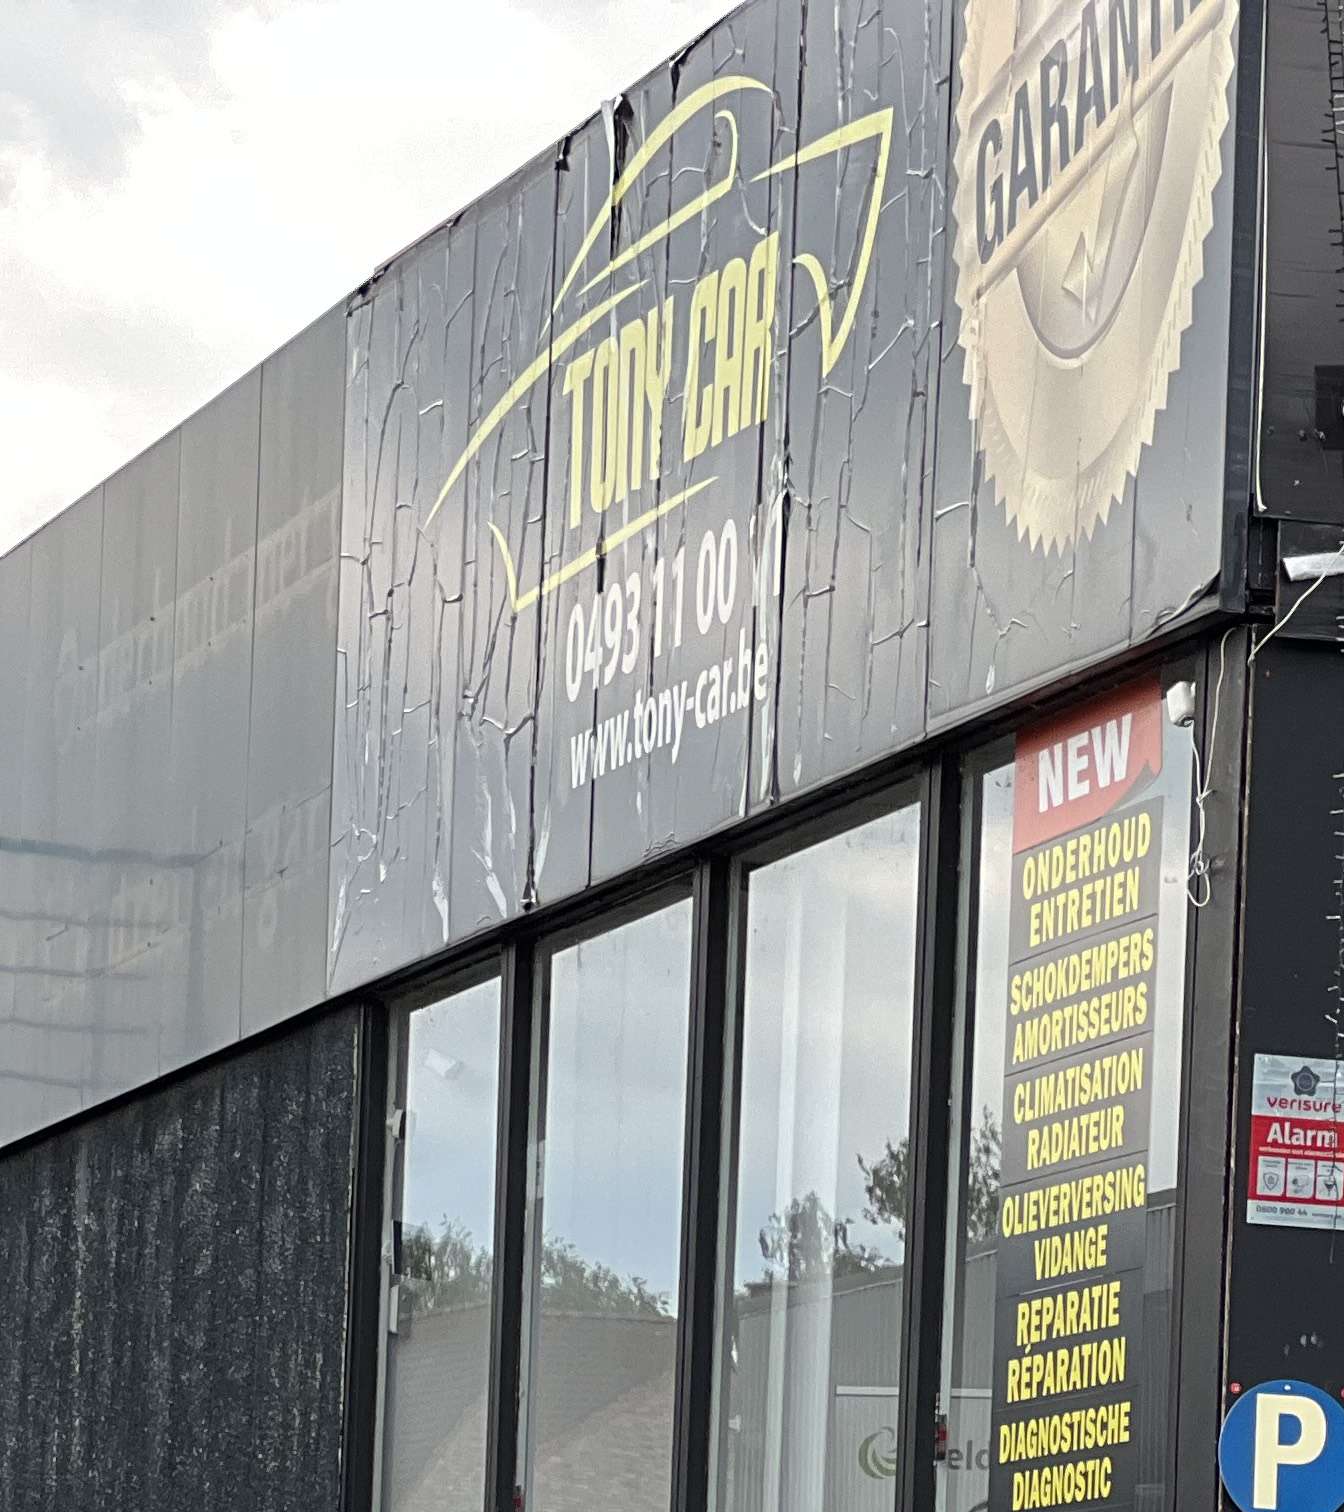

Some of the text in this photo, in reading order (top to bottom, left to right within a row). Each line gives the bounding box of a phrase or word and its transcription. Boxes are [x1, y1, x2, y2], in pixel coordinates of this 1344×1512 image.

[976, 0, 1200, 265] GARAN
[563, 232, 779, 530] TONY CAR
[566, 572, 641, 702] 0493
[652, 547, 686, 658] 11
[696, 519, 738, 634] 00
[570, 628, 768, 788] www.tony-car.be
[1037, 713, 1133, 813] NEW
[1023, 813, 1151, 899] ONDERHOUD
[1029, 867, 1139, 948] ENTRETIEN
[1011, 926, 1154, 1016] SCHOKDEMPERS
[1013, 983, 1147, 1064] AMORTISSEURS
[1014, 1048, 1144, 1124] CLIMATISATION
[1266, 1097, 1342, 1113] verisure
[1027, 1106, 1124, 1170] RADIATEUR
[1266, 1121, 1337, 1148] Alarm
[1002, 1164, 1145, 1238] OLIEVERVERSING
[1034, 1224, 1107, 1281] VIDANGE
[1016, 1281, 1120, 1346] REPARATIE
[1007, 1337, 1126, 1403] RÉPARATION
[998, 1402, 1131, 1463] DIAGNOSTISCHE
[1253, 1393, 1327, 1510] P
[1013, 1459, 1112, 1511] DIAGNOSTIC
